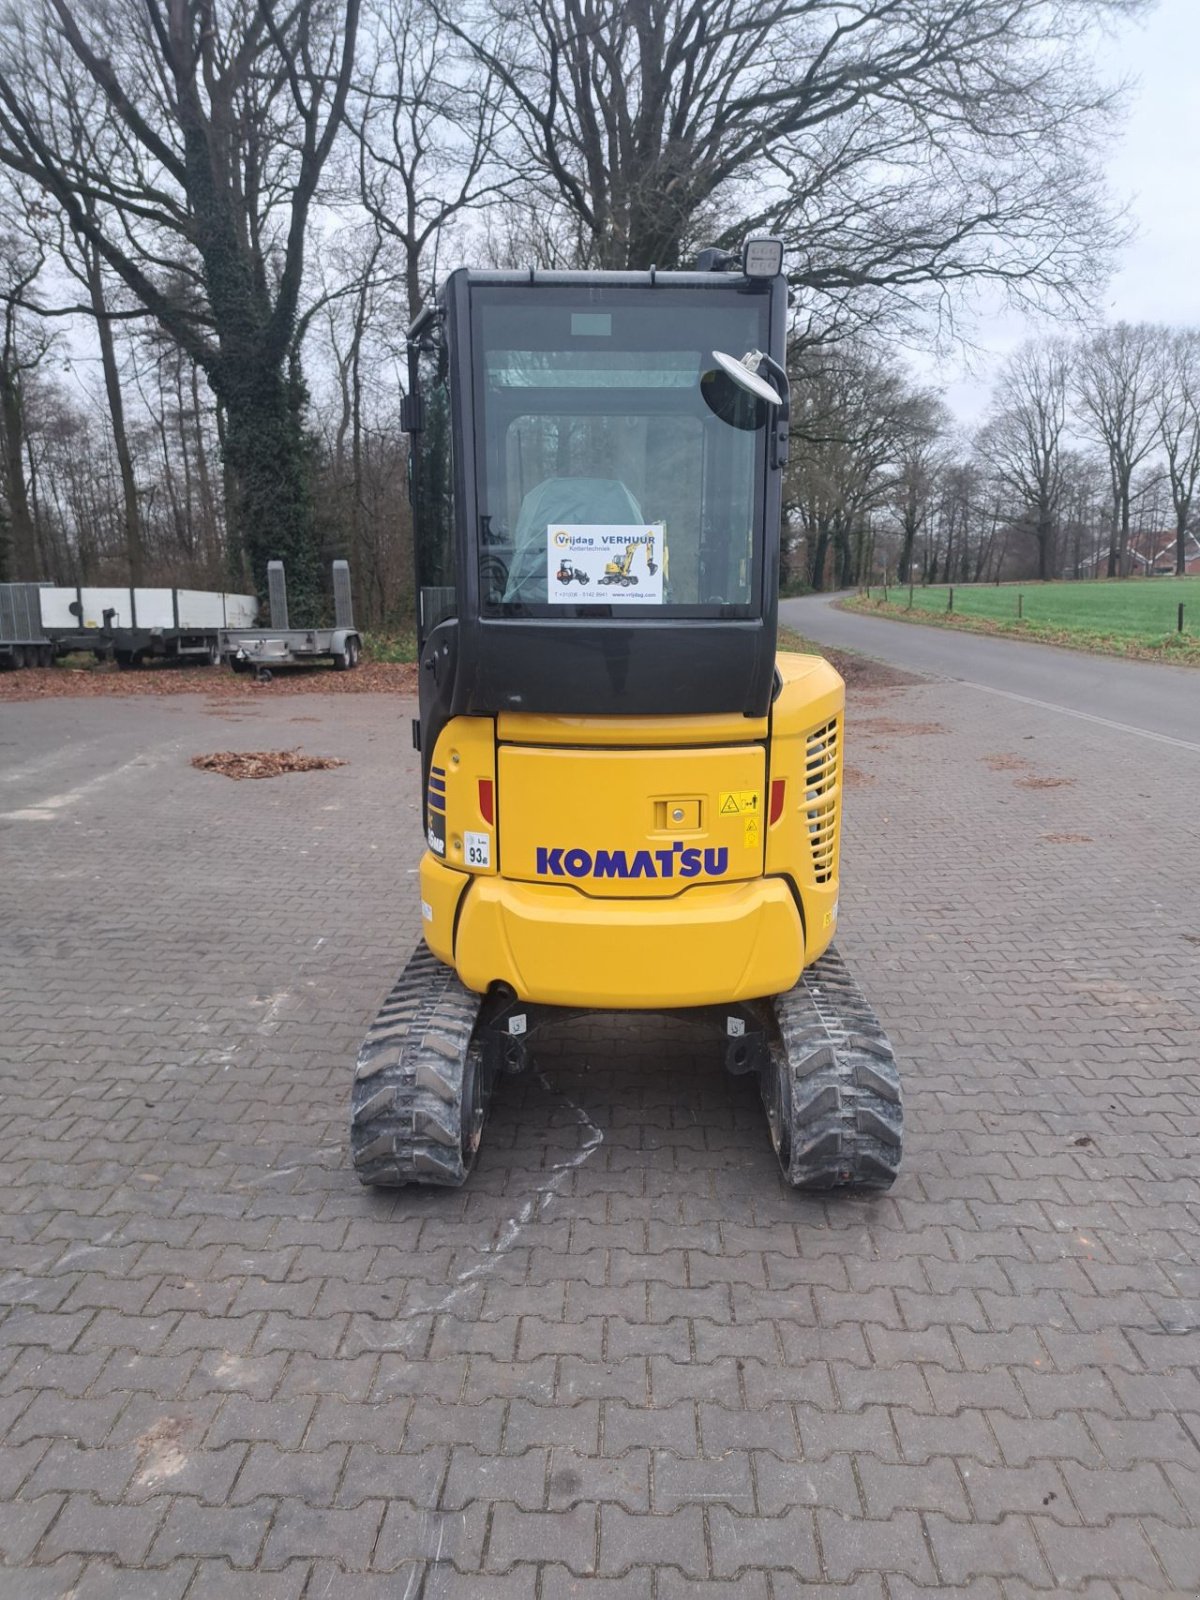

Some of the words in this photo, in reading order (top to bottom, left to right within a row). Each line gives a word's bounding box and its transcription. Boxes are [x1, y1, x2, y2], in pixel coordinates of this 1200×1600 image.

[558, 536, 594, 546] Vrijdag
[601, 536, 655, 544] VERHUUR
[469, 847, 482, 863] 93
[536, 841, 728, 878] KOMATSU
